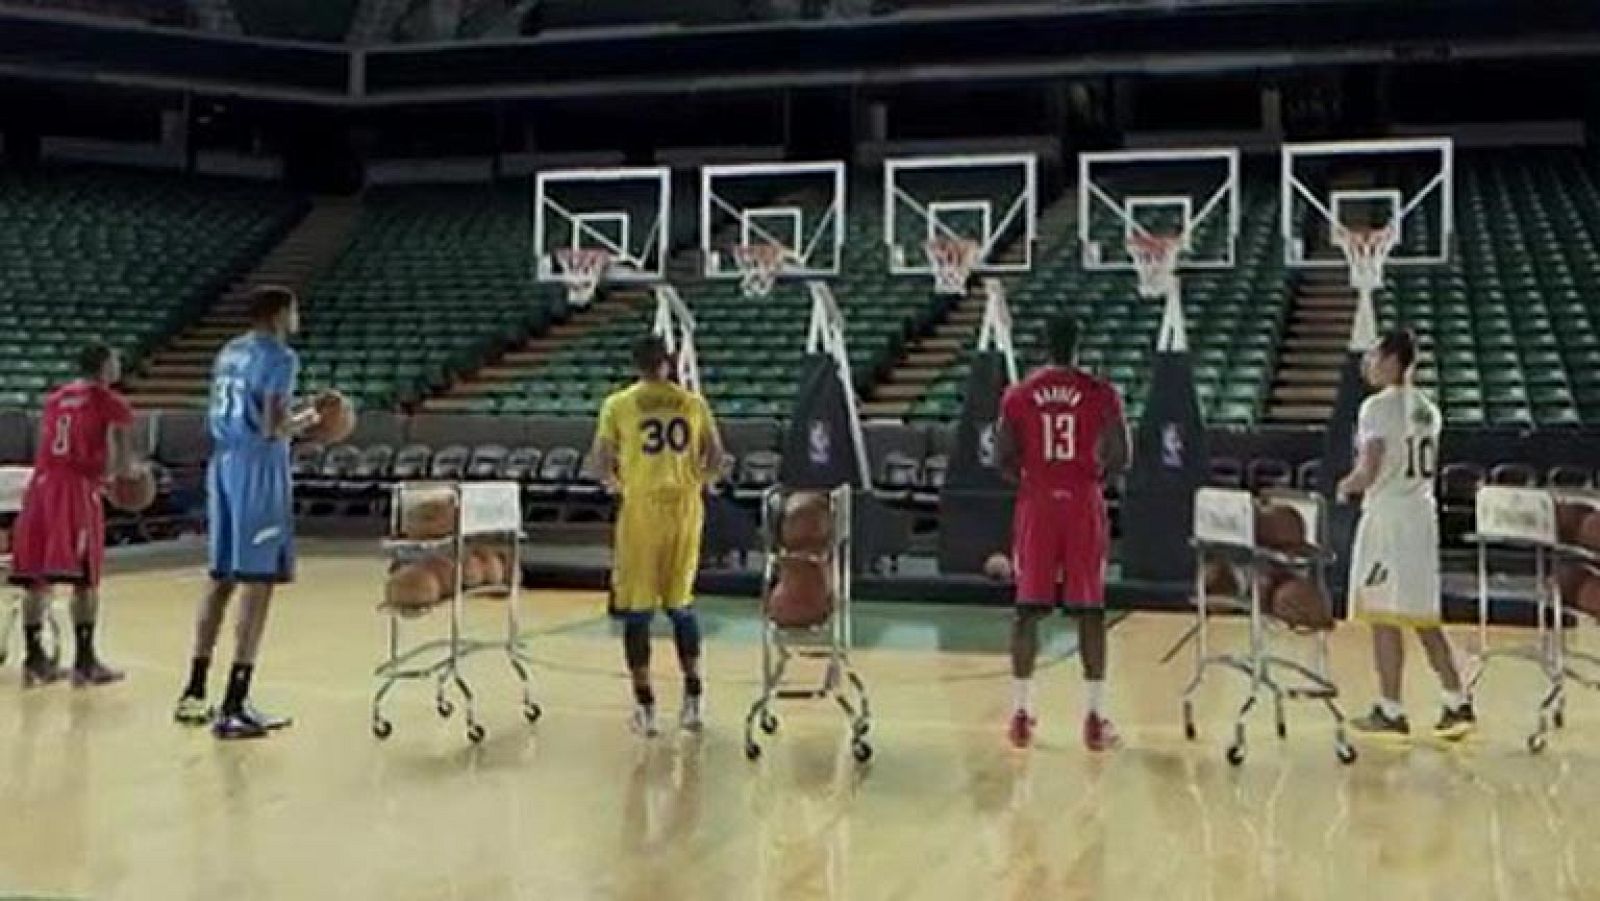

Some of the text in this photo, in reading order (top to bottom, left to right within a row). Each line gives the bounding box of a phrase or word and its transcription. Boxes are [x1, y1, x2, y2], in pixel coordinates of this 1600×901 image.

[640, 417, 689, 455] 30
[1042, 413, 1075, 460] 13
[1405, 435, 1436, 478] 10
